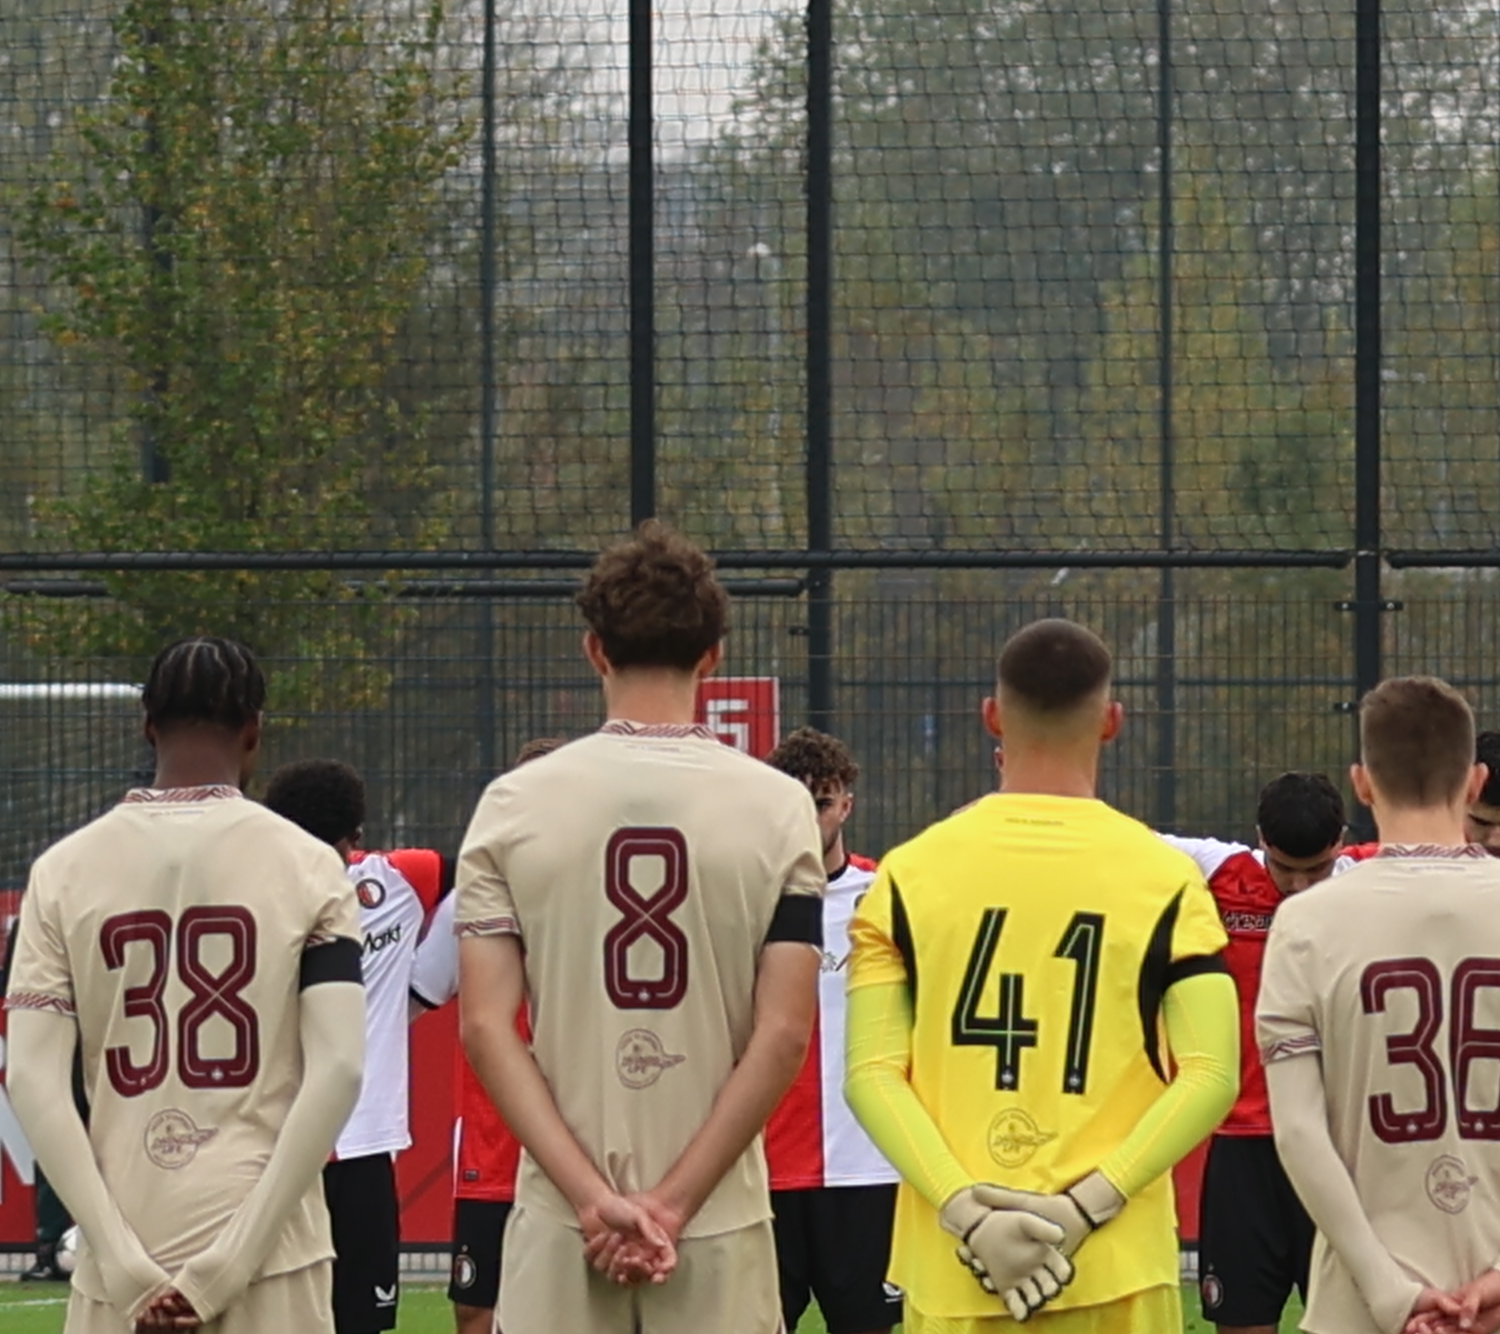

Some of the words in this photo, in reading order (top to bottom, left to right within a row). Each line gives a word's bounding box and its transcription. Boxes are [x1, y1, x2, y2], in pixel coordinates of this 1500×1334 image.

[100, 904, 260, 1098] 38
[604, 827, 689, 1009] 8
[951, 907, 1106, 1095] 41
